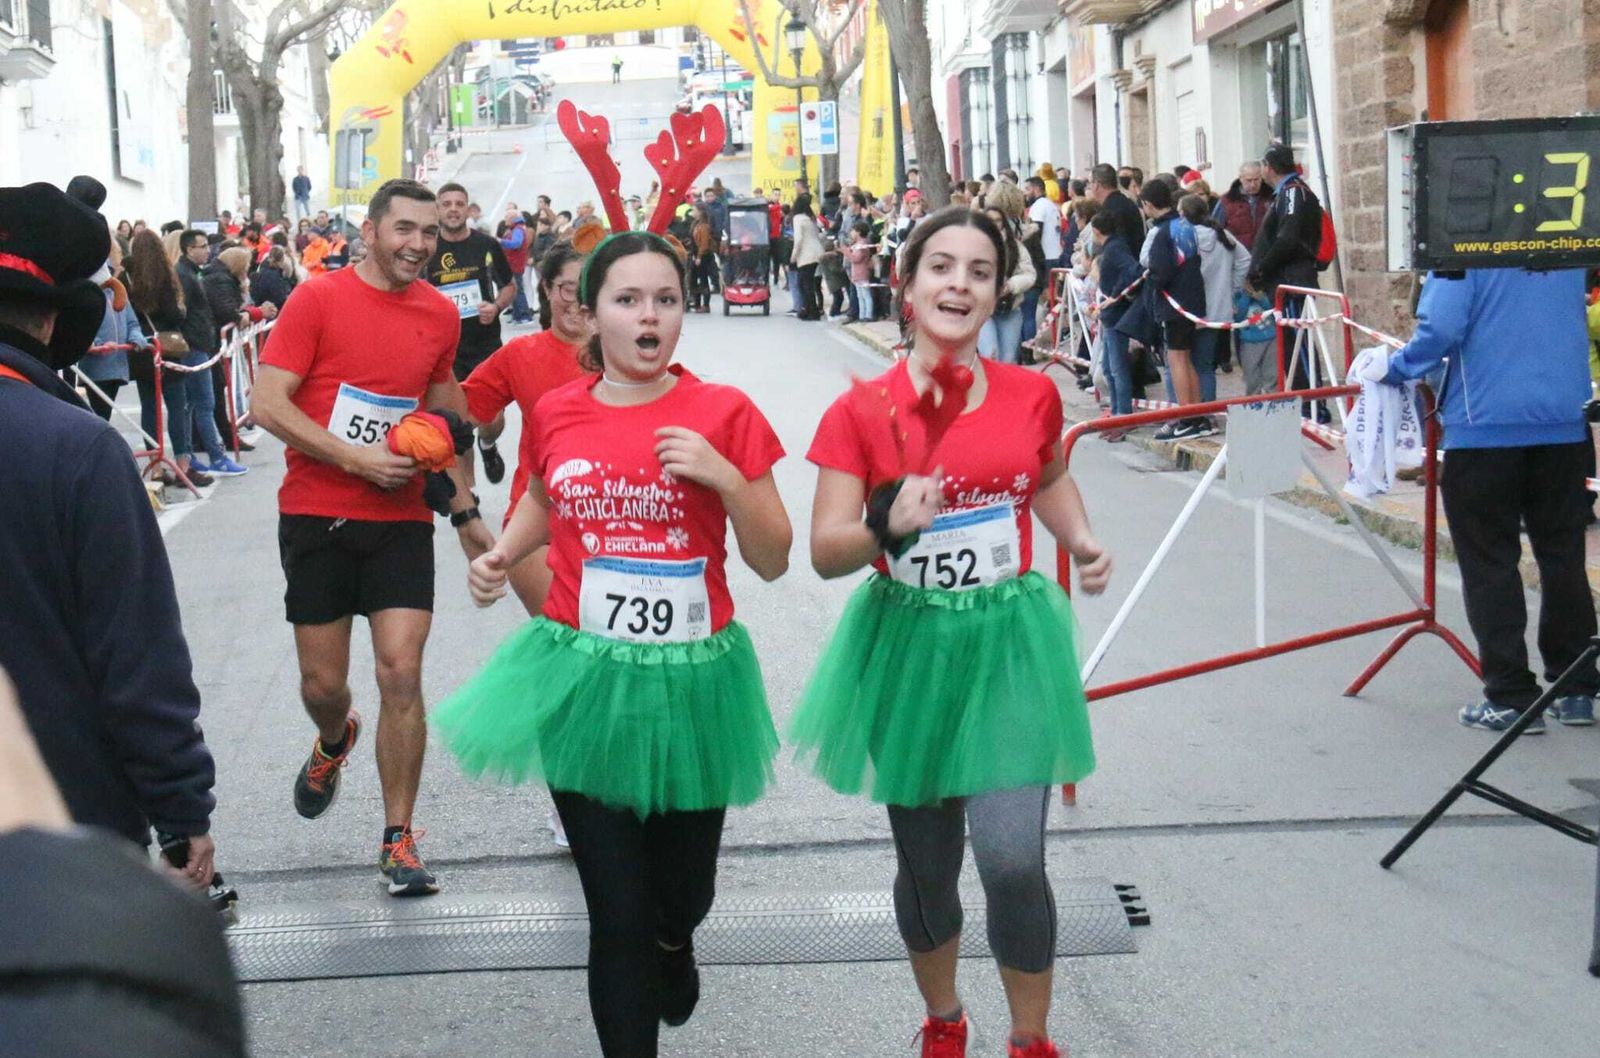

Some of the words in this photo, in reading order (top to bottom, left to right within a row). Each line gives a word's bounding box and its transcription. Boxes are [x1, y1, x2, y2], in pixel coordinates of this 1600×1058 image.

[562, 479, 597, 500] San
[603, 476, 675, 503] Silvestre
[574, 498, 670, 523] CHICLANERA
[604, 541, 666, 553] CHICLANA
[910, 548, 981, 590] 752
[605, 593, 674, 636] 739
